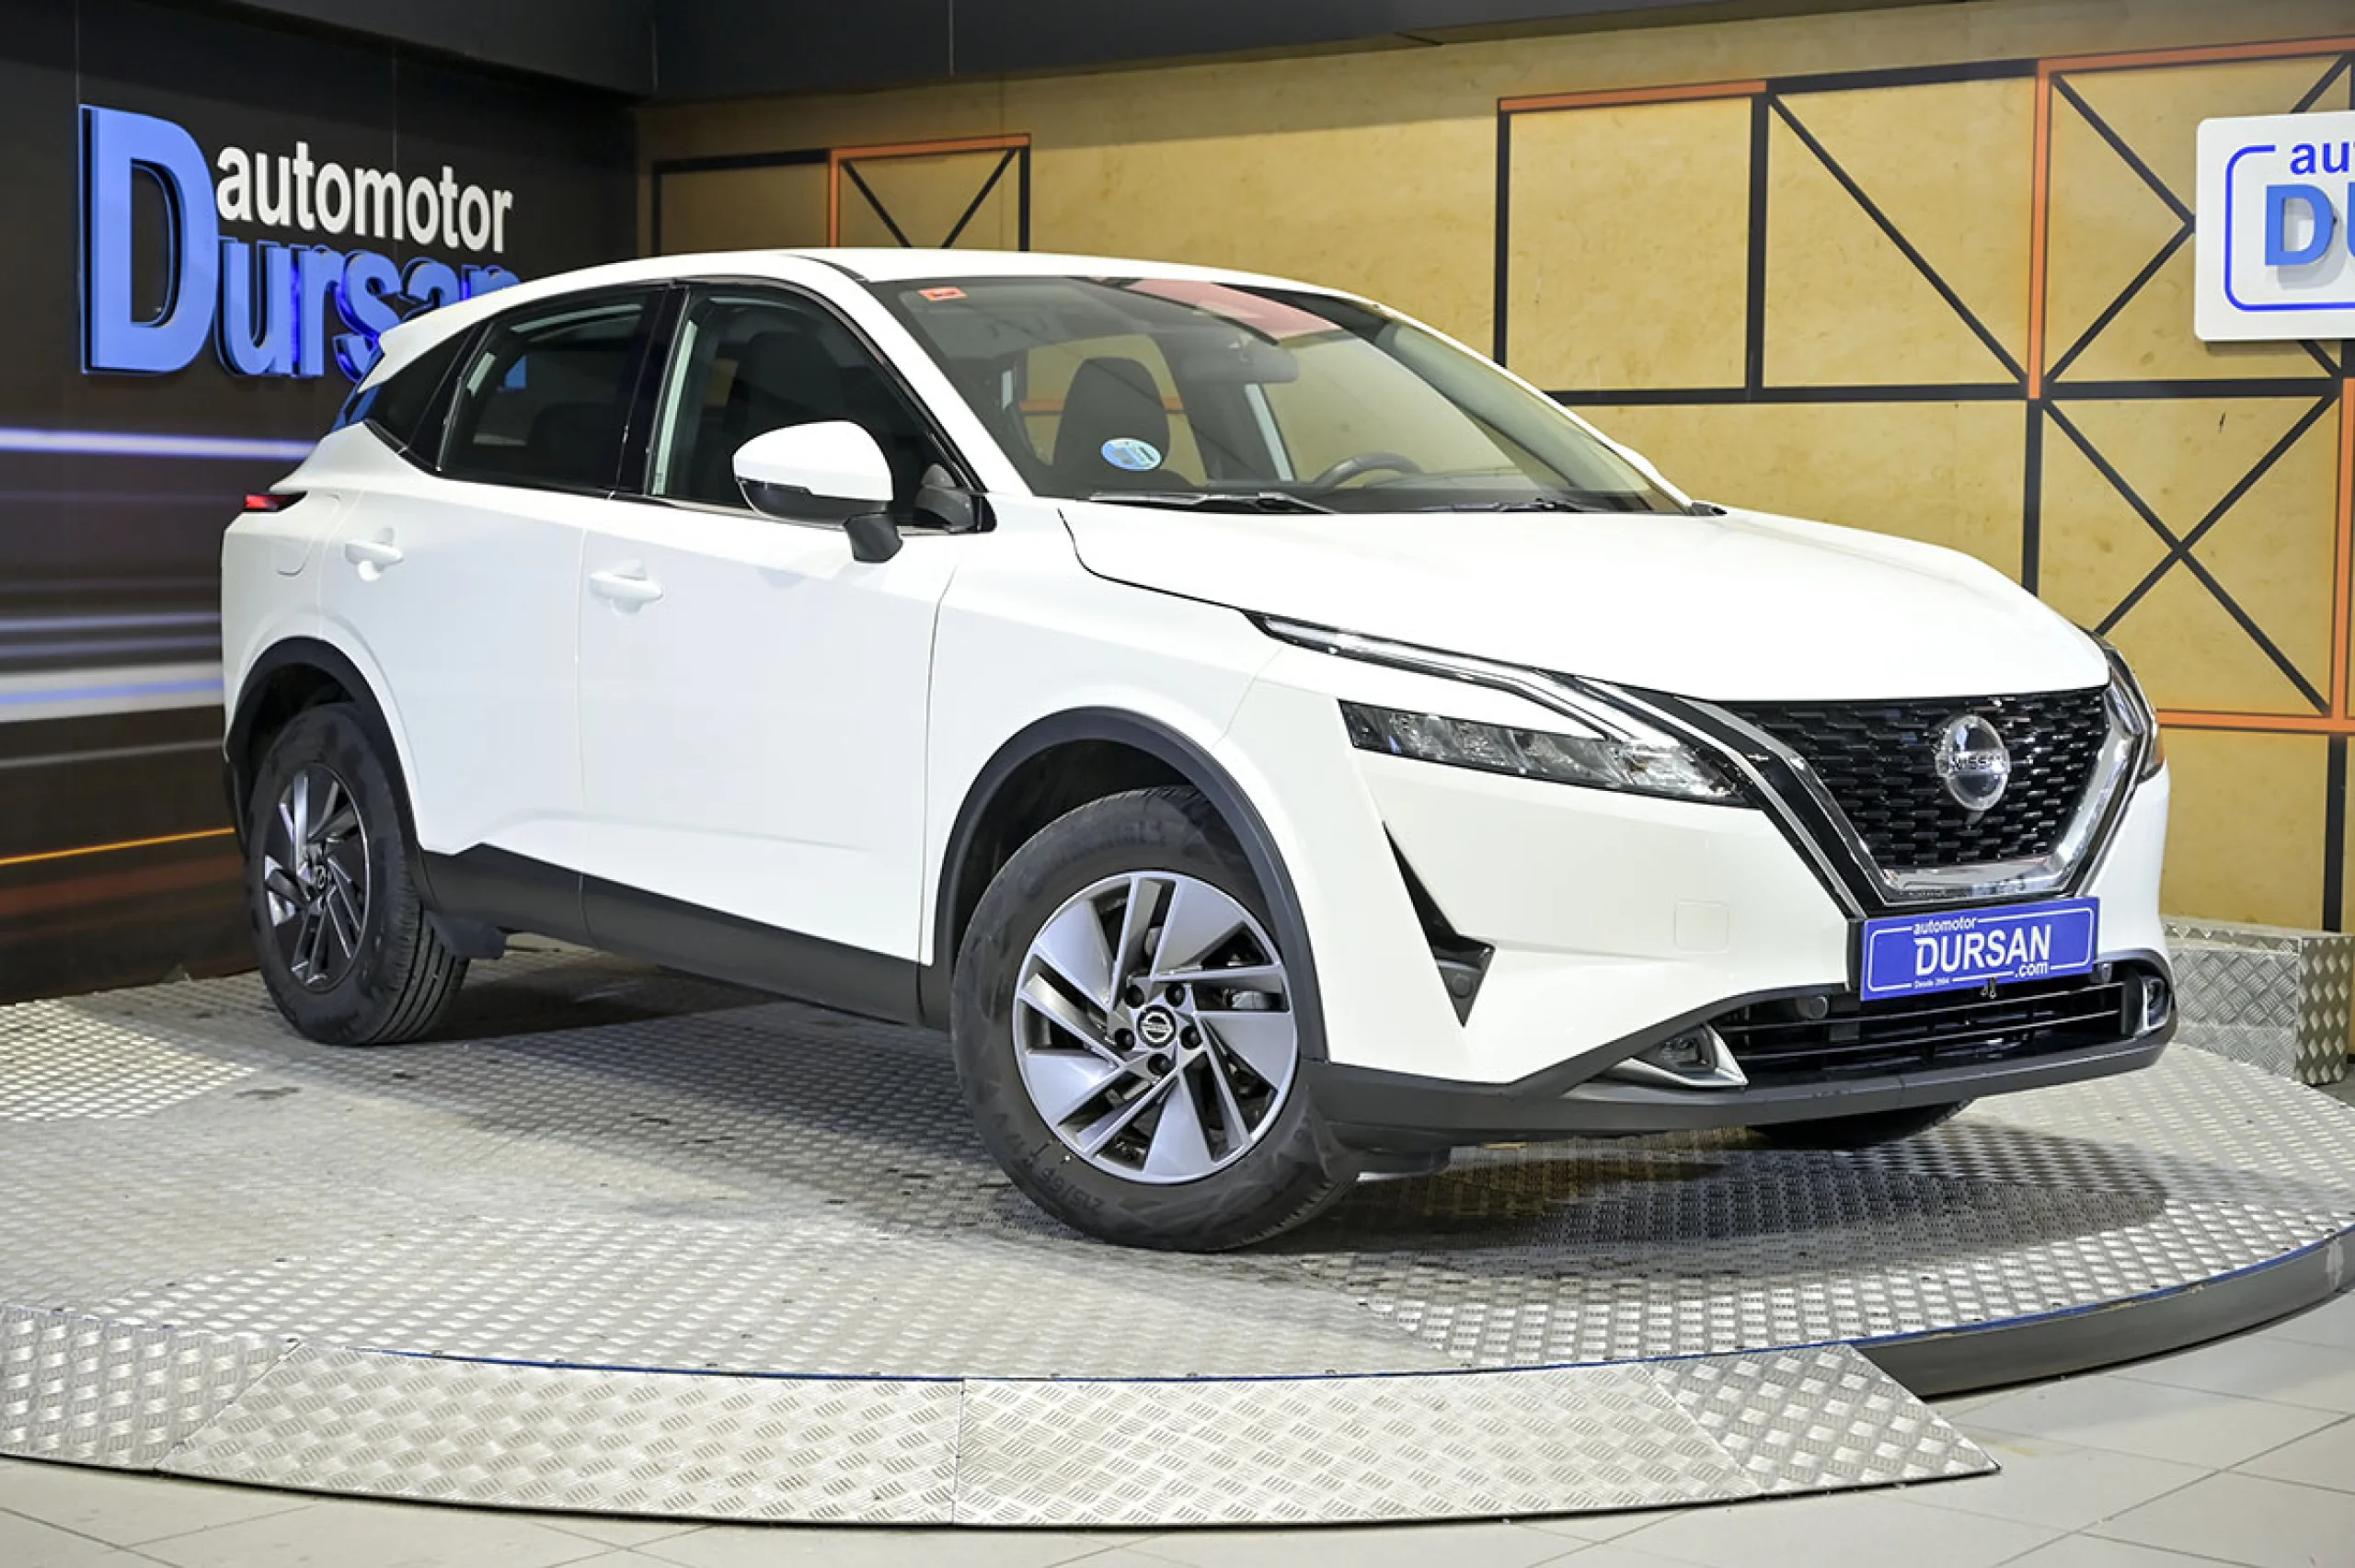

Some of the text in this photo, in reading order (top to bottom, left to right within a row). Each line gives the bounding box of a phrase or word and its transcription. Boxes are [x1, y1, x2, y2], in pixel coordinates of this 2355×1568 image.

[2290, 142, 2355, 175] au
[216, 141, 513, 254] automotor
[2265, 181, 2355, 266] D
[78, 103, 523, 384] Durs
[1913, 917, 1977, 935] automotor
[1913, 923, 2051, 977] DURSAN
[2015, 961, 2048, 978] .com
